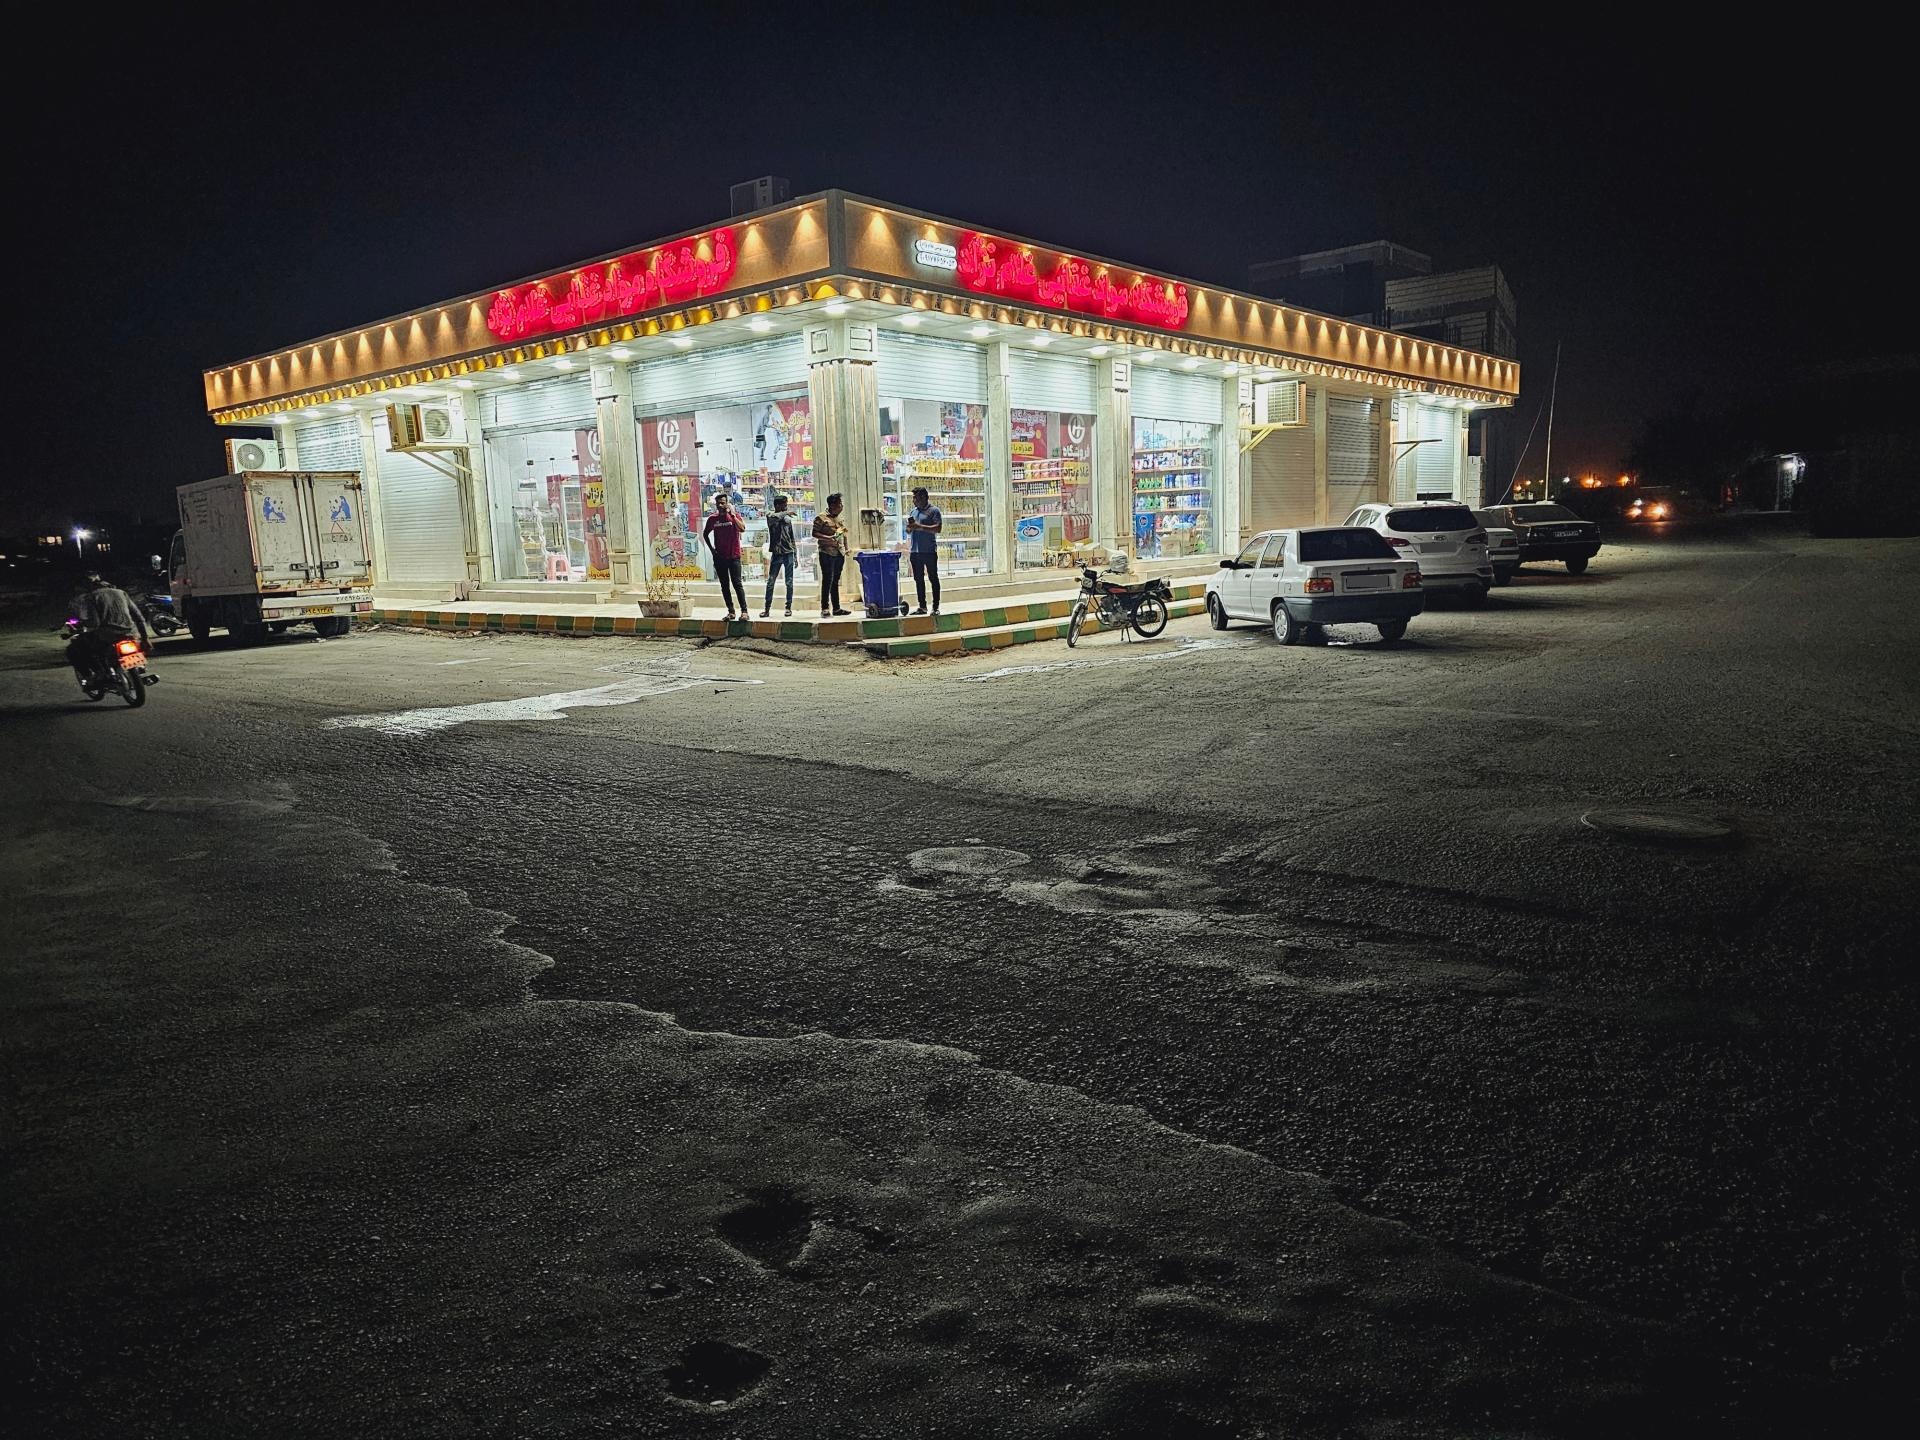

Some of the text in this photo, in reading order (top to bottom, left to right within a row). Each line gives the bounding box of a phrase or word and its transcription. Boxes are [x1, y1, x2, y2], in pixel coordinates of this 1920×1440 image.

[645, 231, 731, 289] فروشگاه
[996, 252, 1038, 290] غلام
[603, 266, 645, 309] مواد
[1092, 274, 1128, 313] مواد
[1128, 282, 1188, 325] فروشگاه
[517, 289, 549, 333] غلام
[653, 452, 689, 474] فروشگاه
